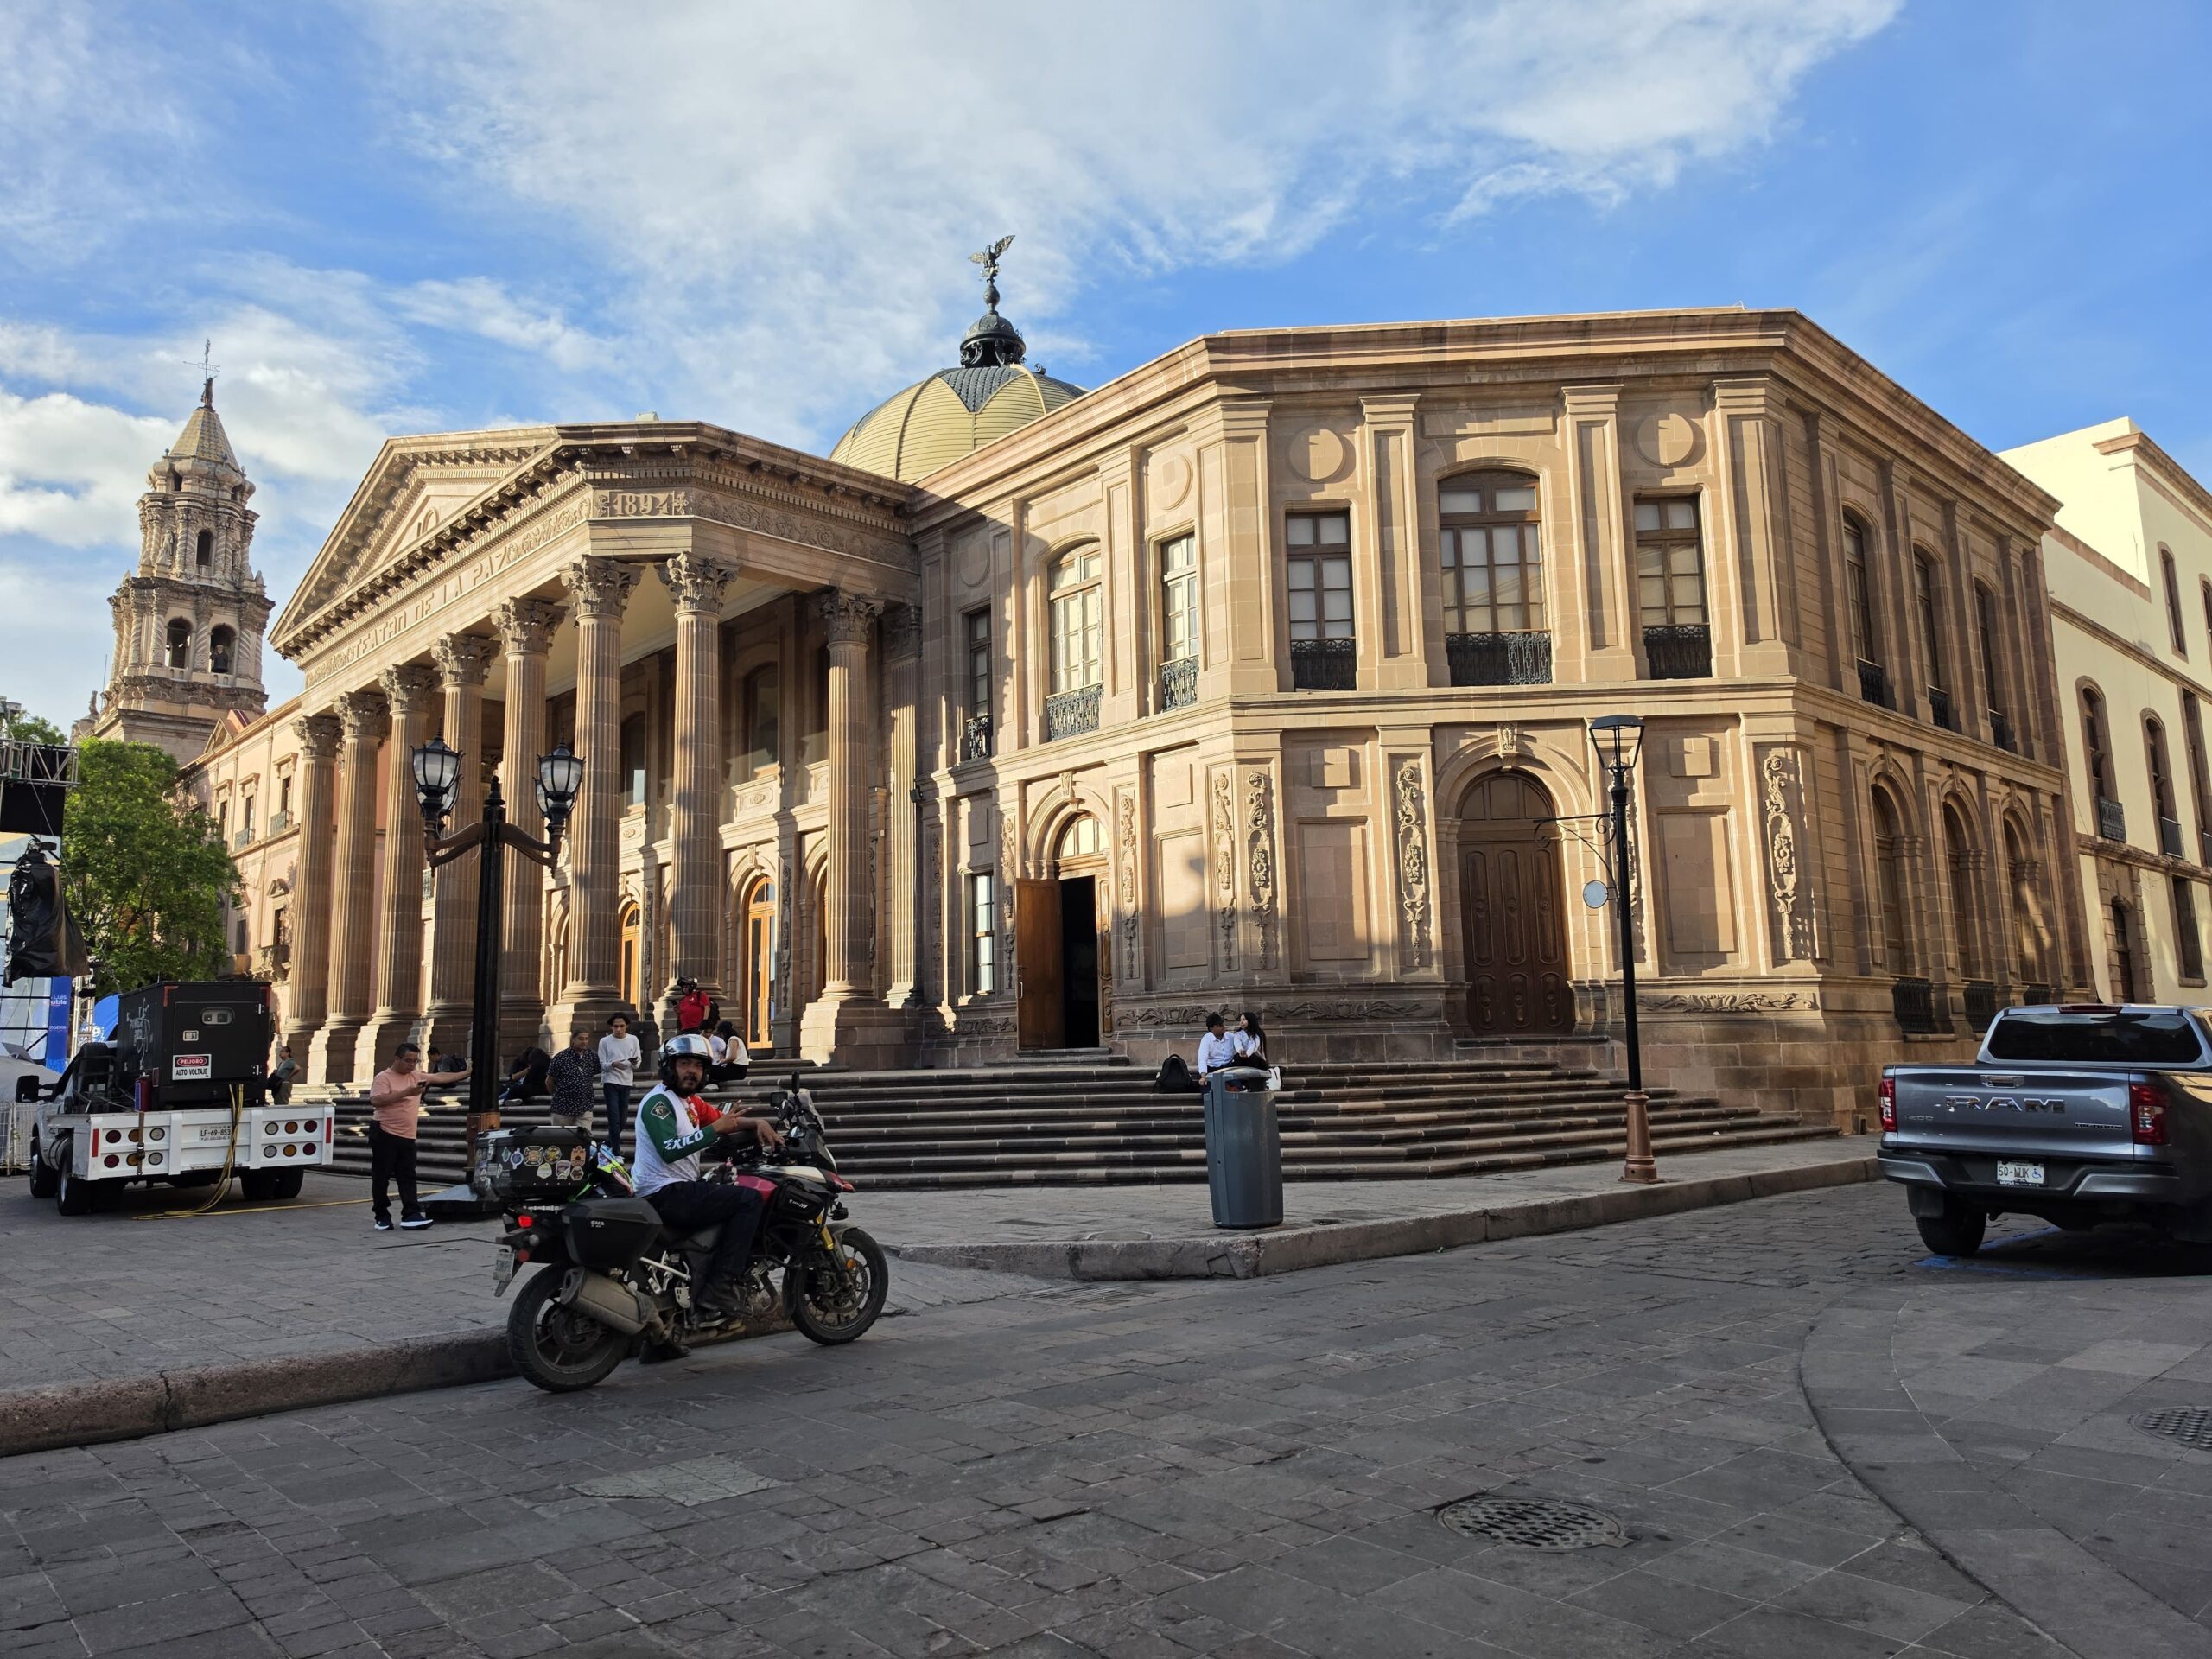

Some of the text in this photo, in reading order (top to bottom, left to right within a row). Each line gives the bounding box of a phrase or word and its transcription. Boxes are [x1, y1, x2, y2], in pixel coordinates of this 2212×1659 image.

[613, 493, 670, 516] 1894
[353, 546, 508, 658] TEATRO DE LA PAZ
[1945, 1095, 2066, 1114] RAM
[663, 1129, 705, 1151] EXICO
